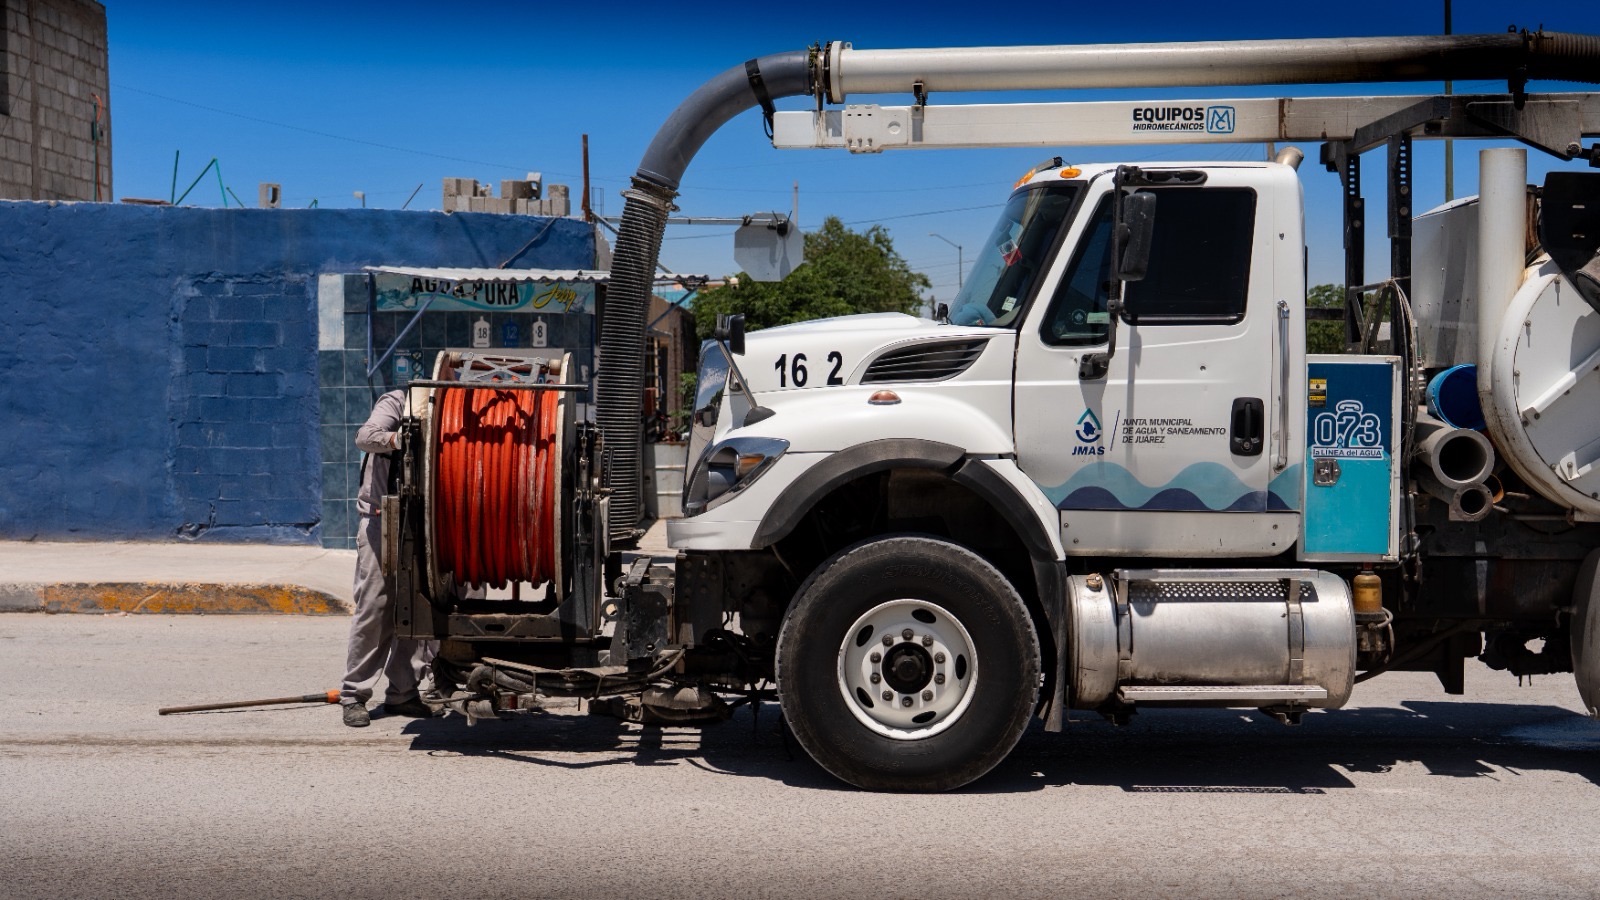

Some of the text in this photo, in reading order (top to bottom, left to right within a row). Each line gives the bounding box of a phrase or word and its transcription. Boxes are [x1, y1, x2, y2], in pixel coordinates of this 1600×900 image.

[1132, 107, 1205, 122] EQUIPOS
[1132, 121, 1205, 131] HIDROMECÁNICOS
[472, 281, 520, 306] PURA
[774, 352, 808, 388] 16
[1122, 418, 1193, 426] JUNTA MUNICIPAL
[1122, 427, 1227, 435] DE AGUA Y SANEAMIENTO
[1315, 411, 1382, 447] 073
[1122, 434, 1166, 444] DE JUÁREZ
[1071, 446, 1106, 456] JMAS
[1313, 448, 1320, 456] la
[1346, 448, 1358, 456] del
[1360, 448, 1382, 456] AGUA
